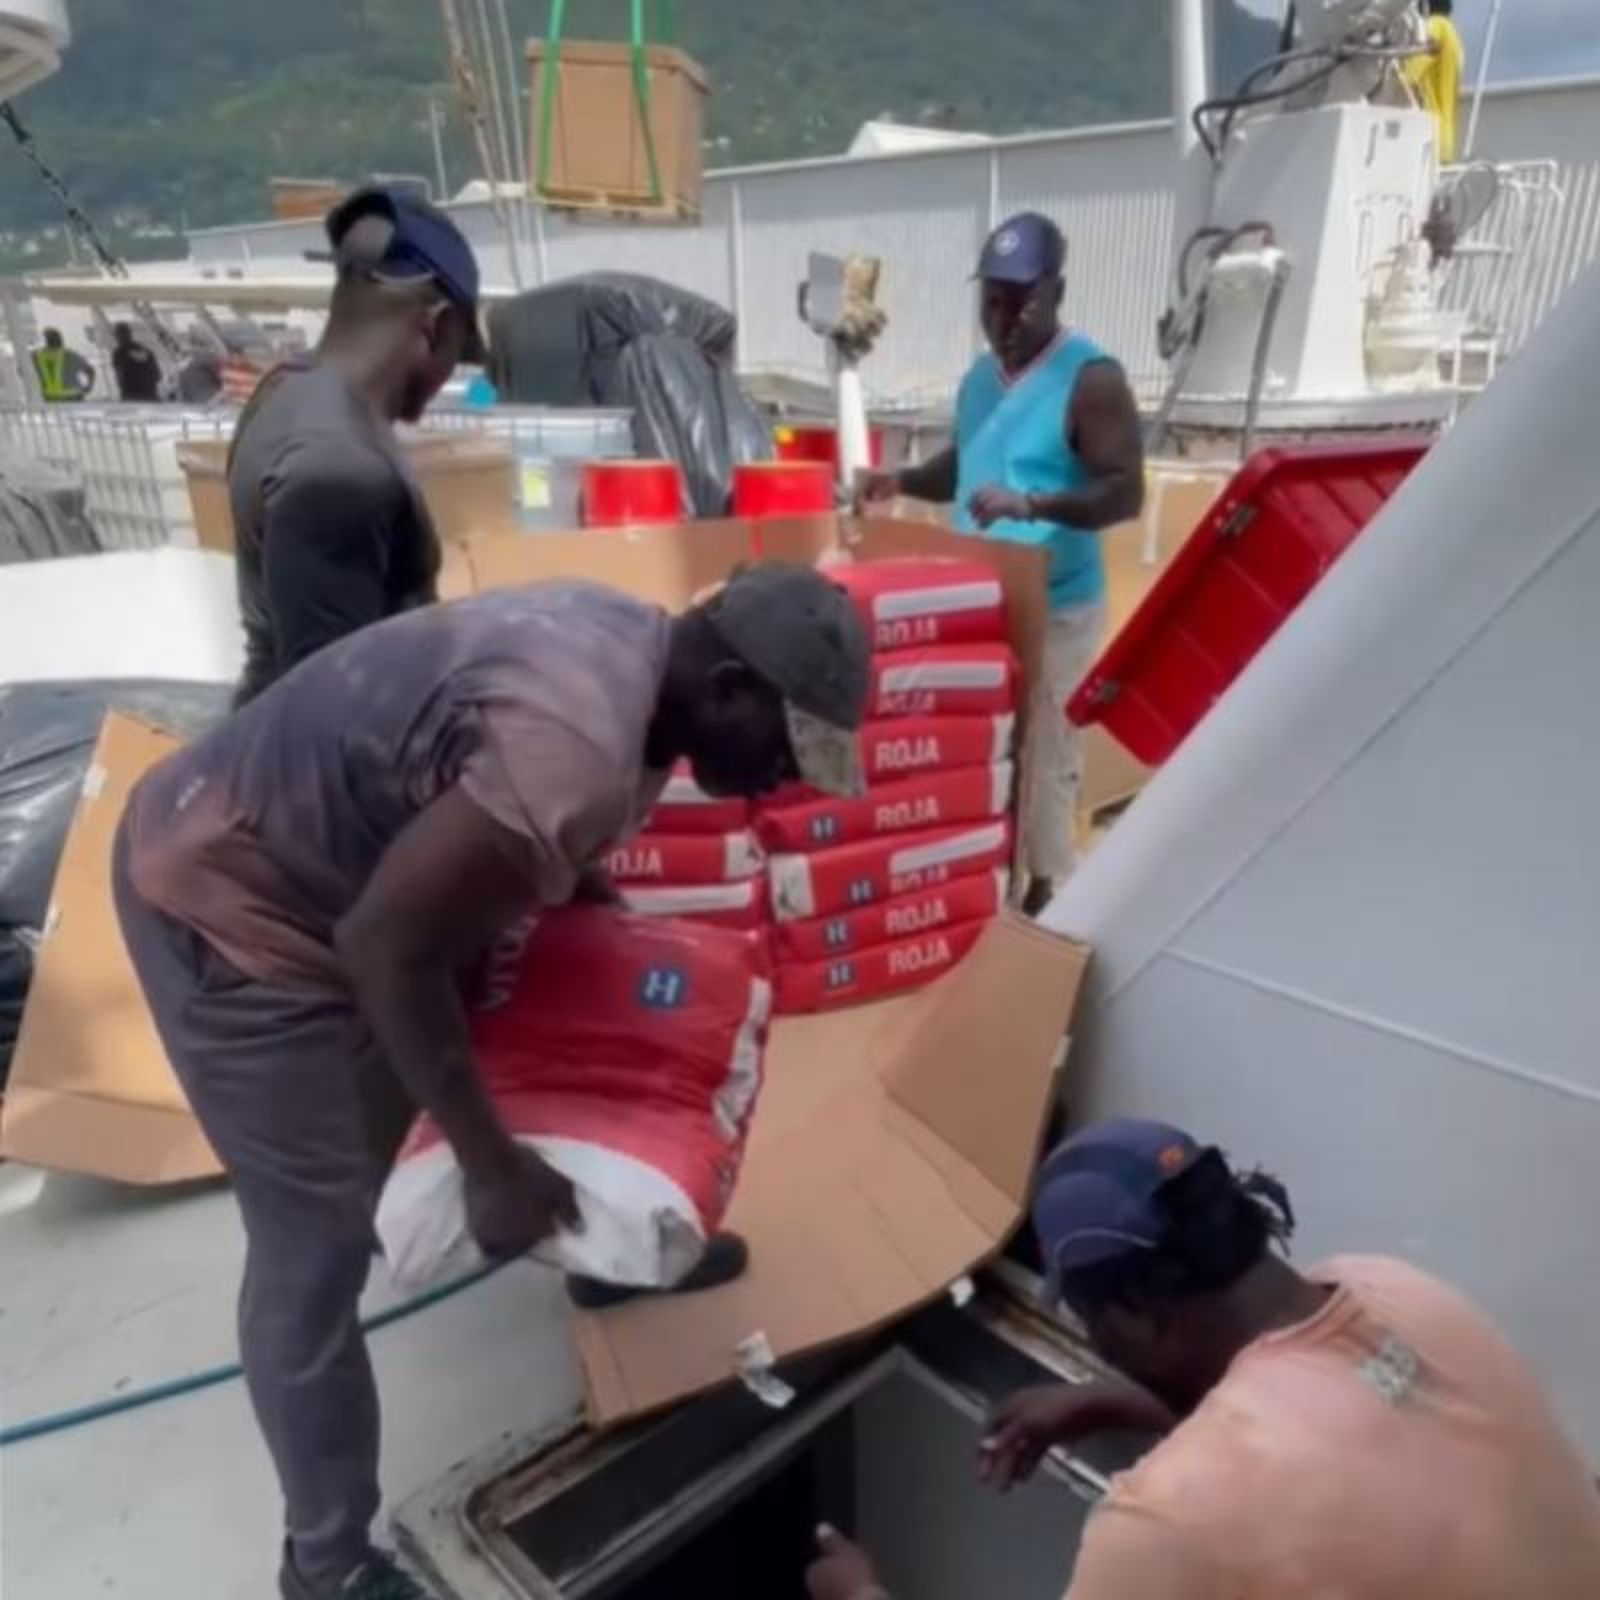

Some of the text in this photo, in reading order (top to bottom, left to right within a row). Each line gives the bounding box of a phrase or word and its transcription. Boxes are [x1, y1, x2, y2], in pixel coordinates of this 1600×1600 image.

[874, 736, 941, 770] ROJA
[874, 797, 940, 831] ROJA
[885, 898, 948, 935] ROJA
[888, 937, 952, 976] ROJA
[644, 969, 682, 1004] H
